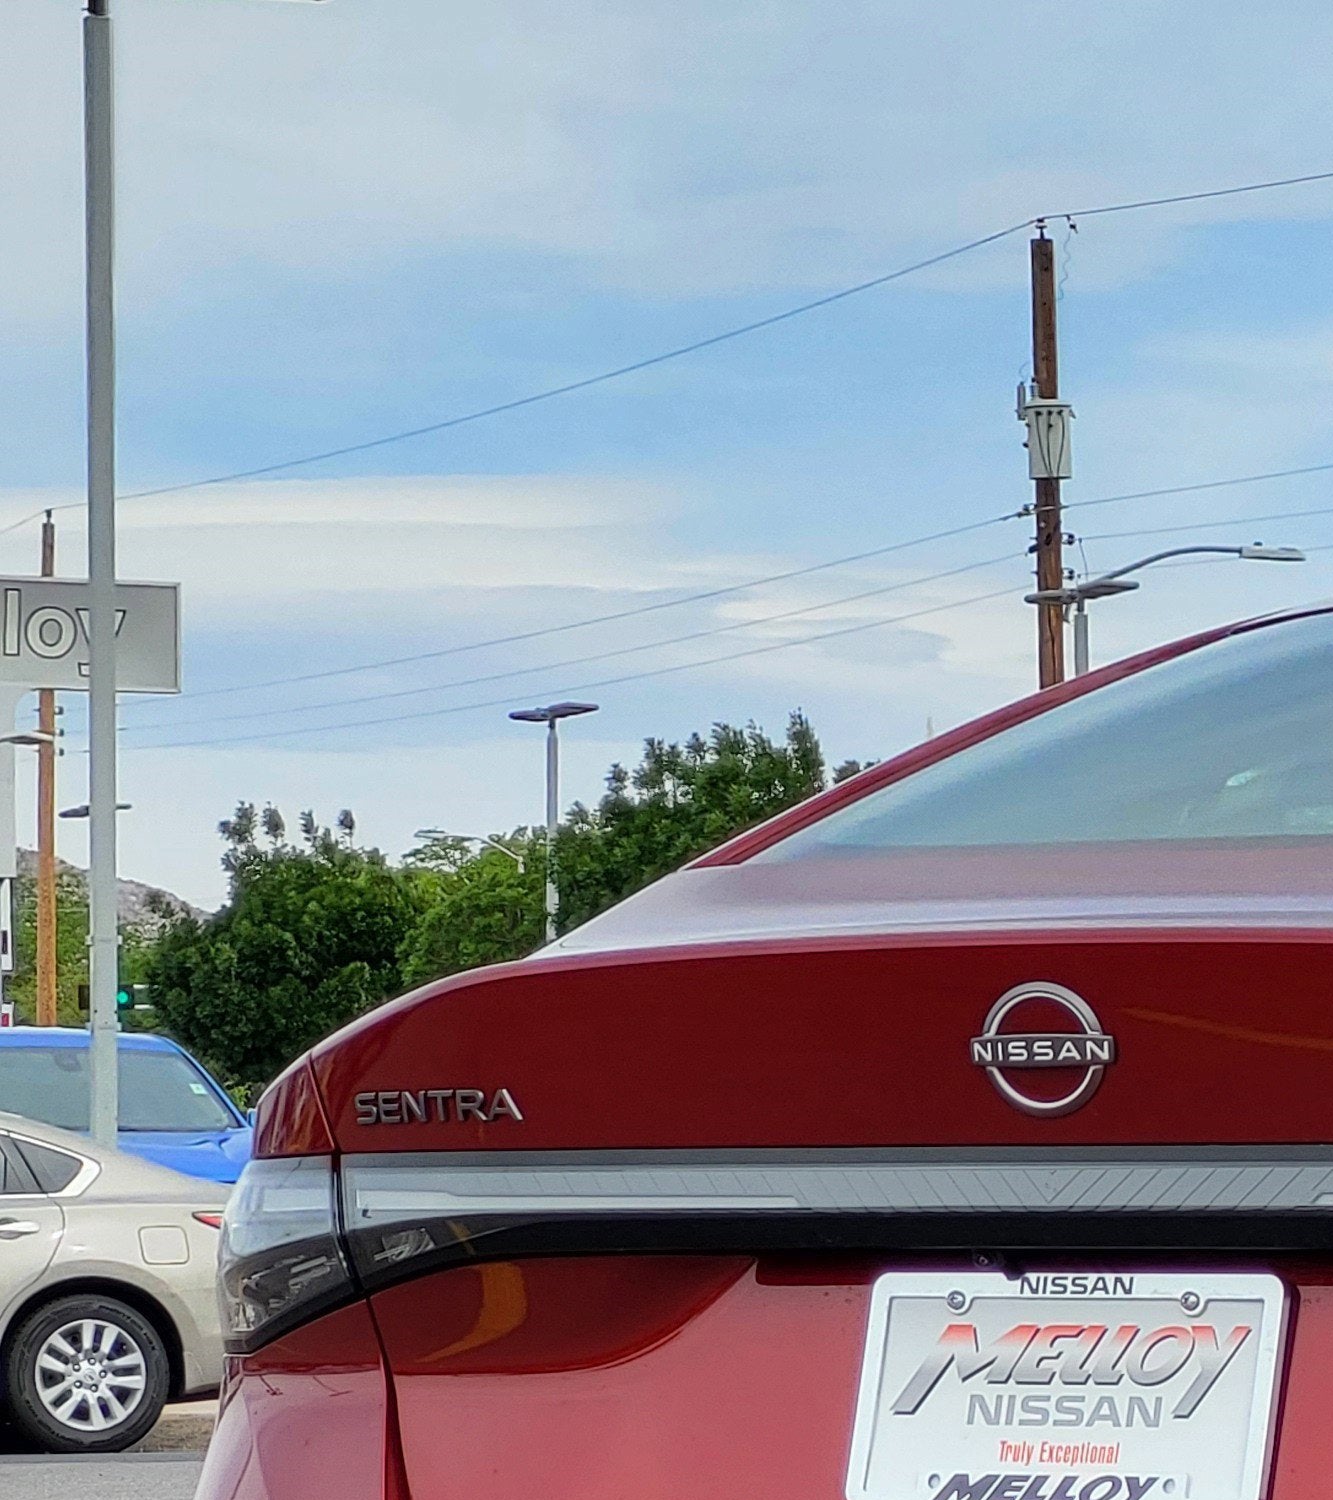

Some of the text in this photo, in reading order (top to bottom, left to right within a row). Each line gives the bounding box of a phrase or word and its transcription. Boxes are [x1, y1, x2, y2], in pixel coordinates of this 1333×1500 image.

[971, 1038, 1112, 1065] NISSAN
[353, 1087, 525, 1127] SENTRA
[1019, 1275, 1135, 1296] NISSAN
[889, 1323, 1253, 1420] MELLOY
[966, 1393, 1164, 1428] NISSAN
[998, 1440, 1121, 1467] Truly Exceptional
